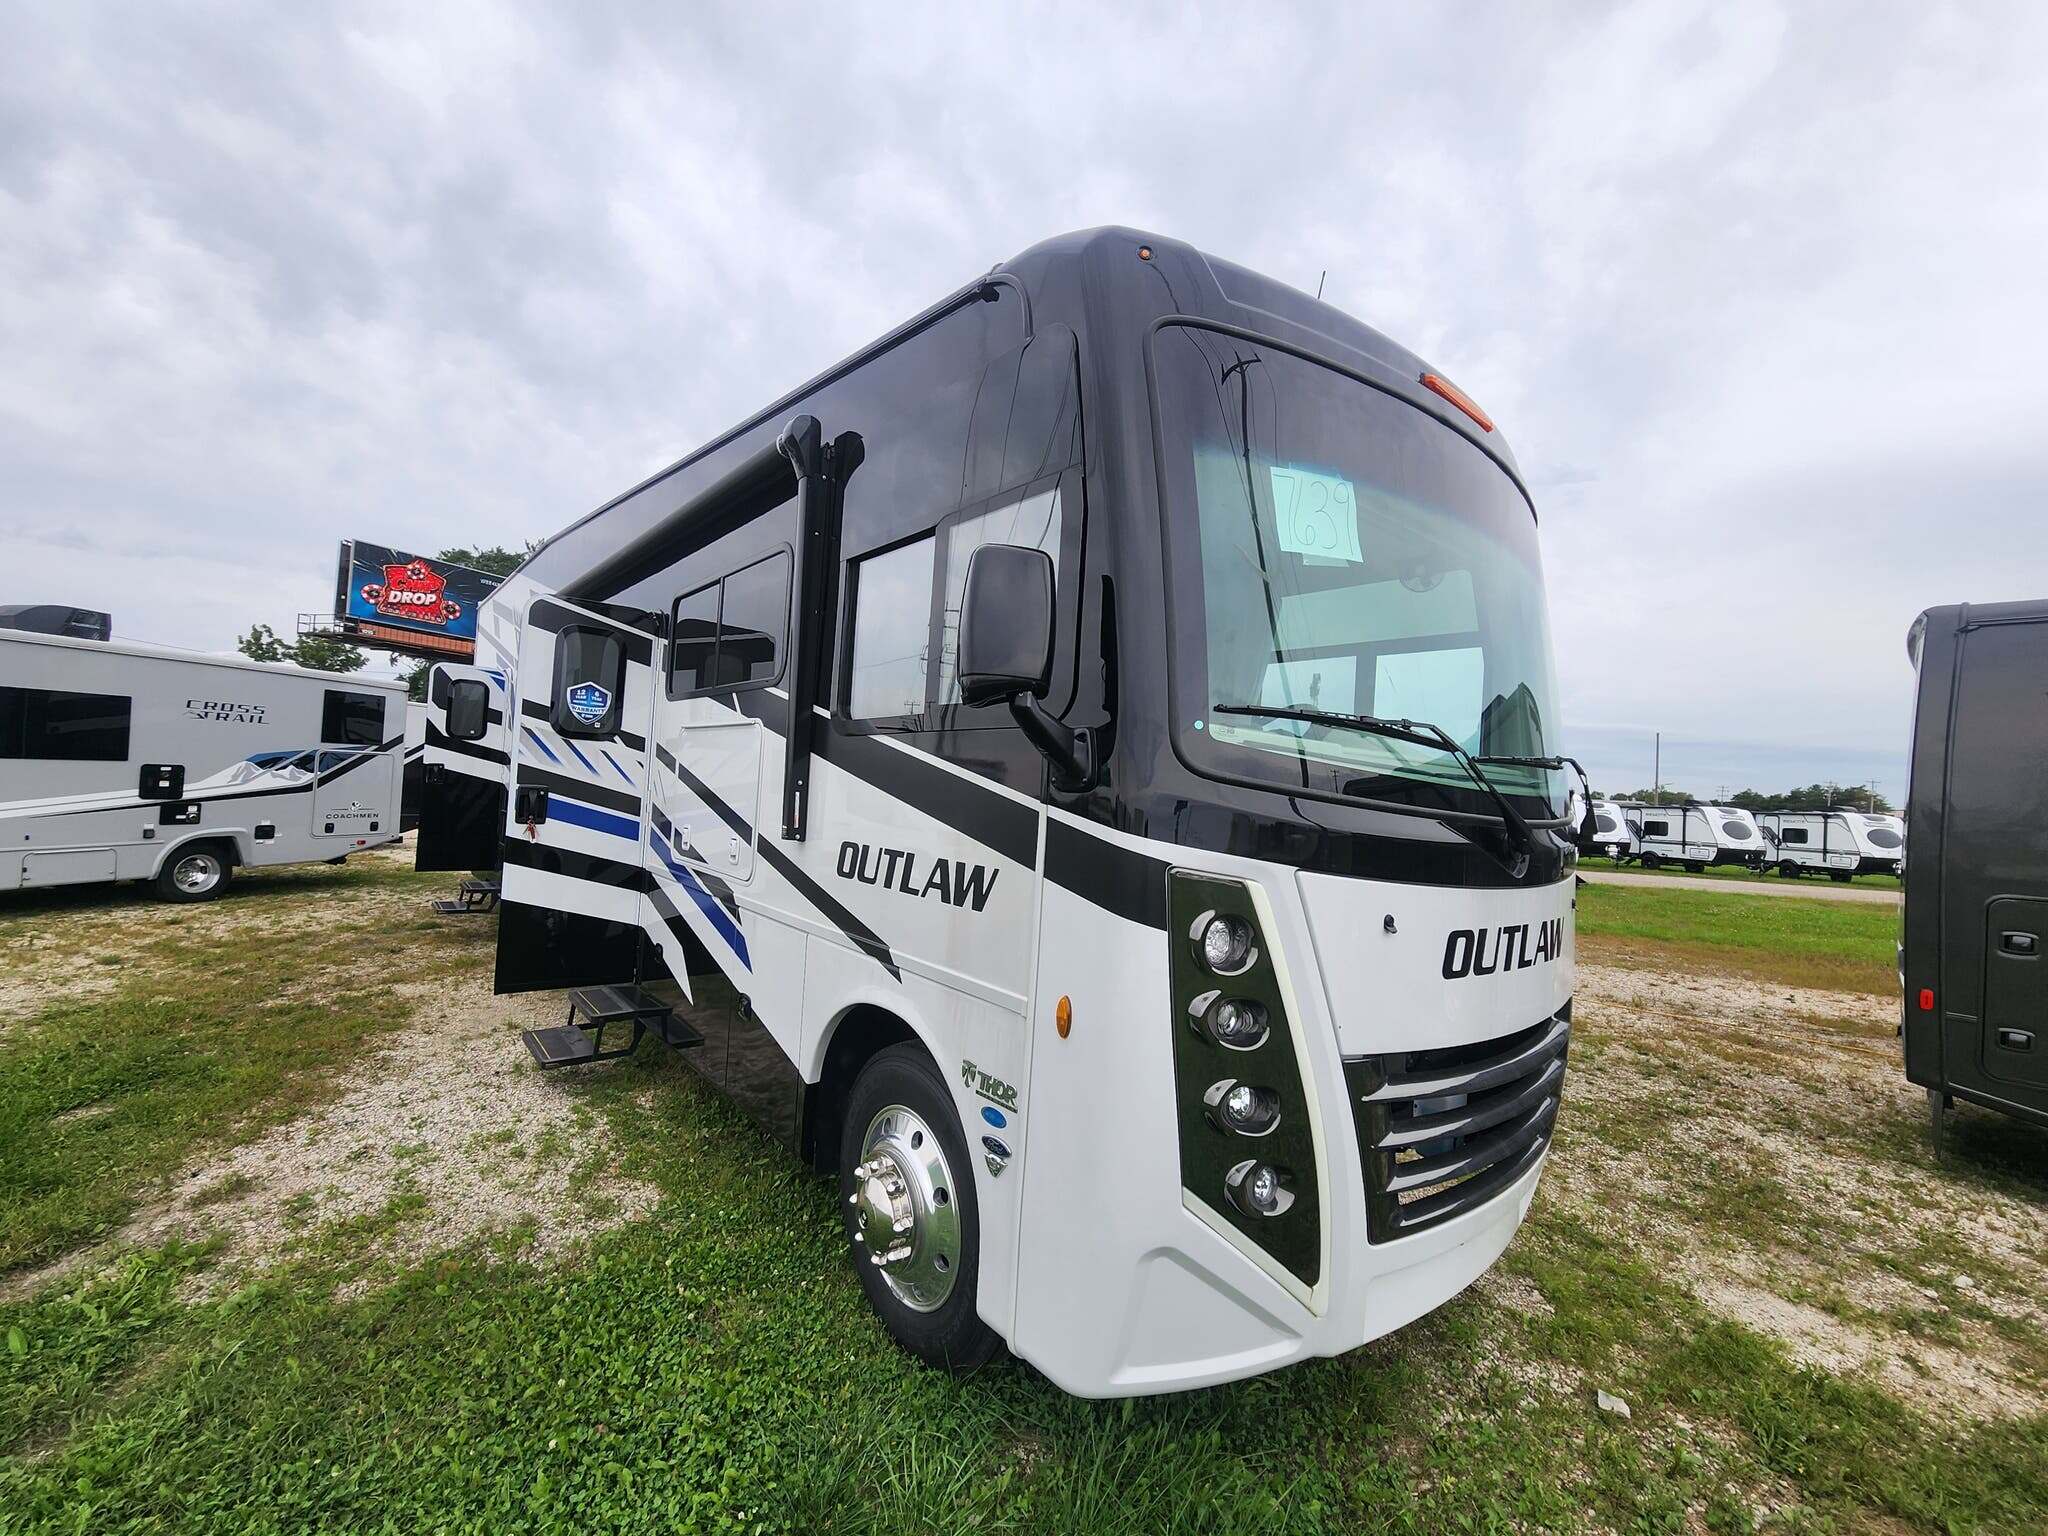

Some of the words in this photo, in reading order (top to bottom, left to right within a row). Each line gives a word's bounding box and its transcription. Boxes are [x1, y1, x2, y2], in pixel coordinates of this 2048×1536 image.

[1272, 473, 1354, 557] 7639
[388, 590, 437, 606] DROP
[186, 699, 266, 715] CROSS
[201, 710, 270, 725] TRAIL
[325, 812, 379, 820] COACHMEN
[836, 840, 1000, 913] OUTLAW
[1441, 916, 1565, 980] OUTLAW
[977, 1070, 1018, 1107] THOR
